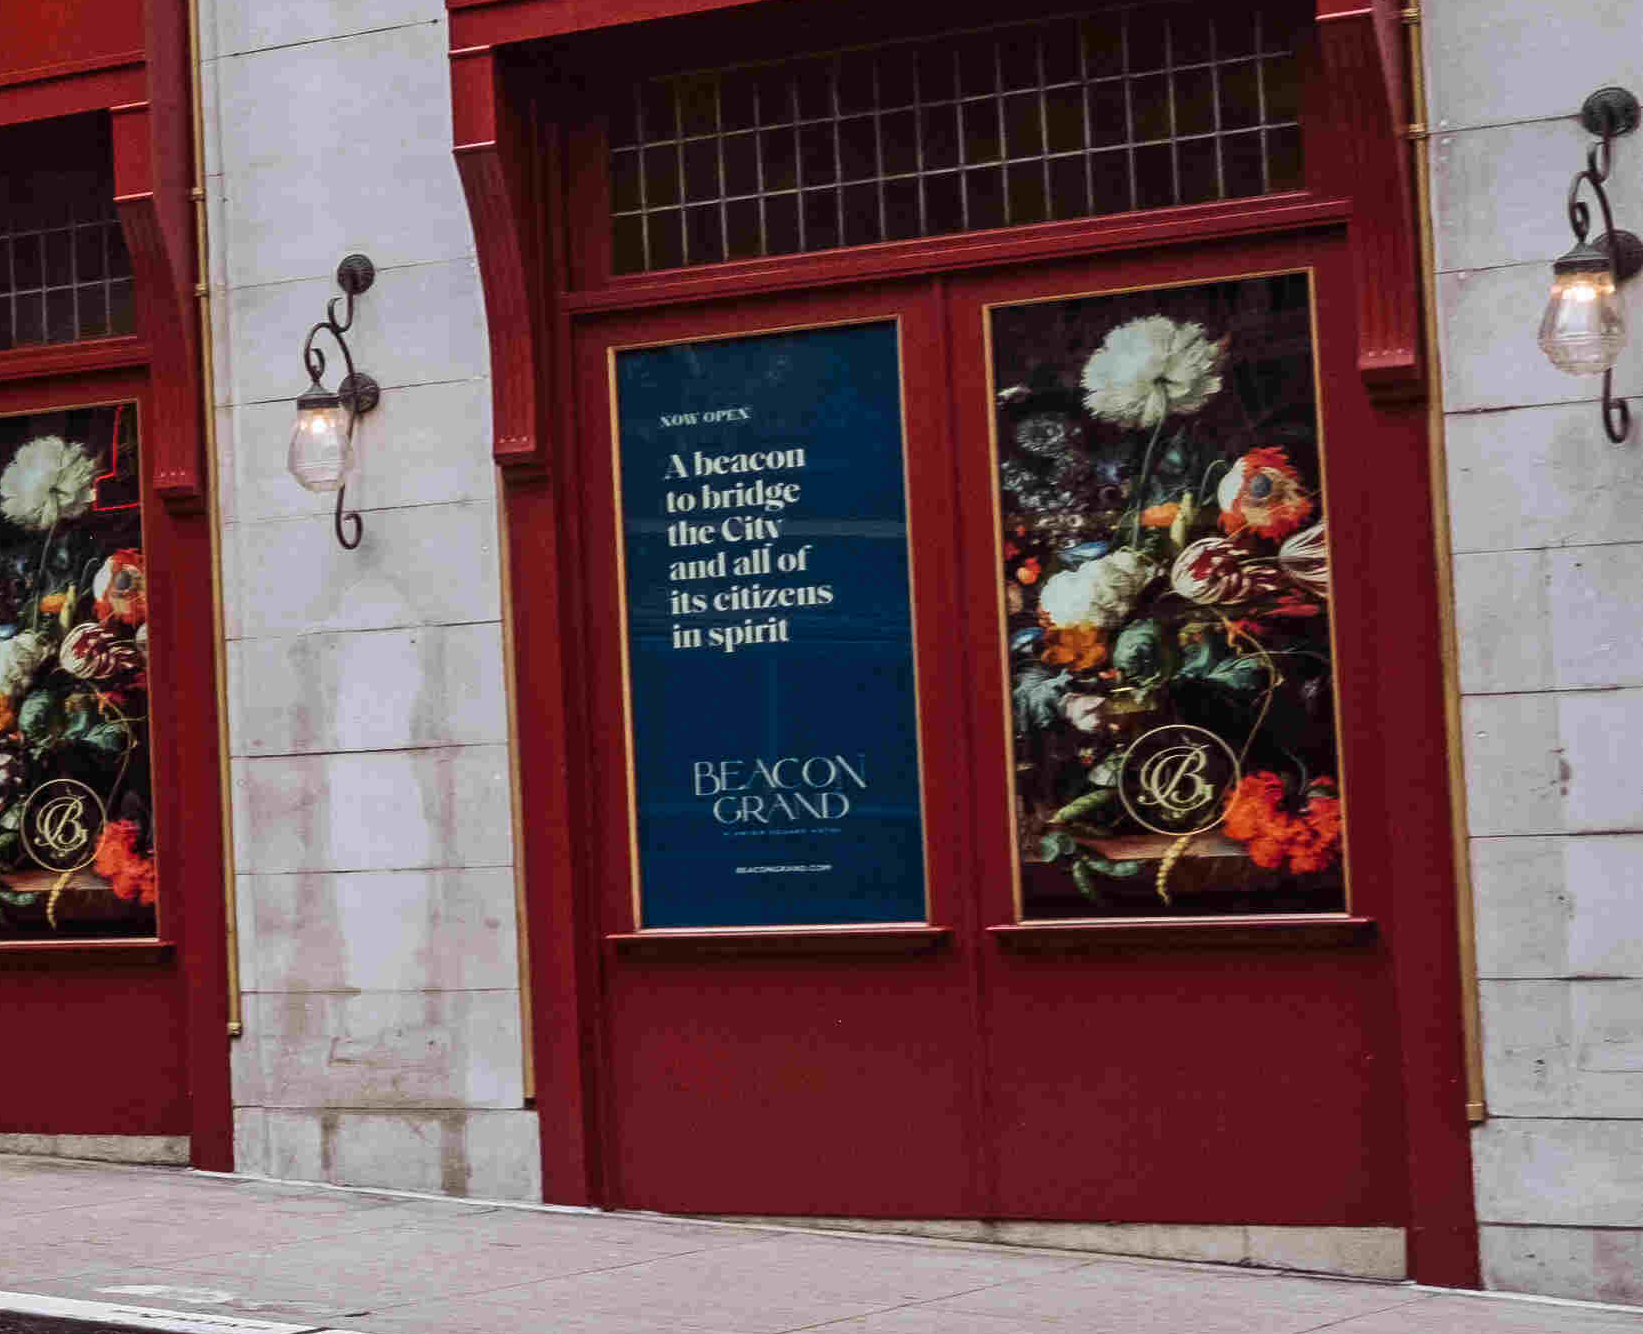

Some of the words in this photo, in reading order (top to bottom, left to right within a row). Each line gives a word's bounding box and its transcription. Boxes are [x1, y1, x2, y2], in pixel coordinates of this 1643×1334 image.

[660, 412, 699, 428] NOW
[703, 405, 752, 424] OPEN
[664, 453, 689, 479] A
[693, 447, 806, 476] beacon
[666, 489, 696, 513] to
[701, 479, 801, 512] bridge
[667, 521, 716, 547] the
[721, 515, 784, 547] City
[669, 551, 726, 581] and
[733, 547, 770, 577] all
[777, 544, 813, 572] of
[669, 589, 708, 615] its
[713, 584, 834, 612] citizens
[672, 624, 702, 649] in
[708, 617, 790, 653] spirit
[692, 753, 868, 796] BEACON
[712, 792, 850, 824] GRAND
